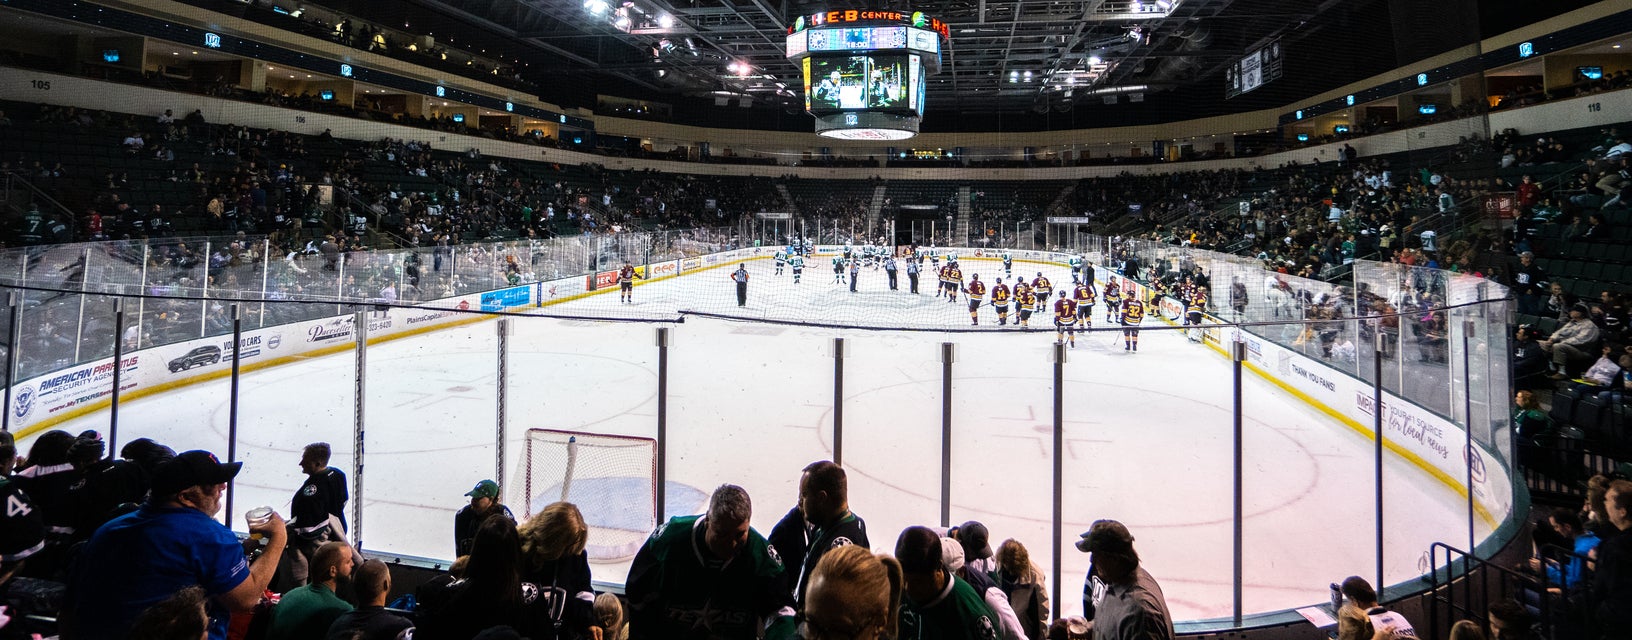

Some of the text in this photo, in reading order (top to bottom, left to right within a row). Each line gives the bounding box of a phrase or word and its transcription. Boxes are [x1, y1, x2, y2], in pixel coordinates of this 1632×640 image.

[861, 11, 901, 20] CENTER
[31, 79, 50, 90] 105
[1588, 103, 1601, 112] 118
[296, 116, 305, 124] 106
[30, 221, 39, 233] 7
[997, 291, 1006, 300] 14
[1081, 289, 1088, 298] 6
[1062, 305, 1070, 316] 7
[1128, 305, 1140, 316] 32
[246, 335, 262, 347] CARS
[39, 368, 93, 391] AMERICAN
[1292, 363, 1336, 392] THANK YOU FANS!
[52, 377, 92, 394] SECURITY
[1356, 393, 1387, 418] IMPAT
[1389, 405, 1407, 419] YOUR
[1416, 418, 1443, 439] SOURCE
[1427, 436, 1449, 459] news
[7, 494, 32, 517] 4
